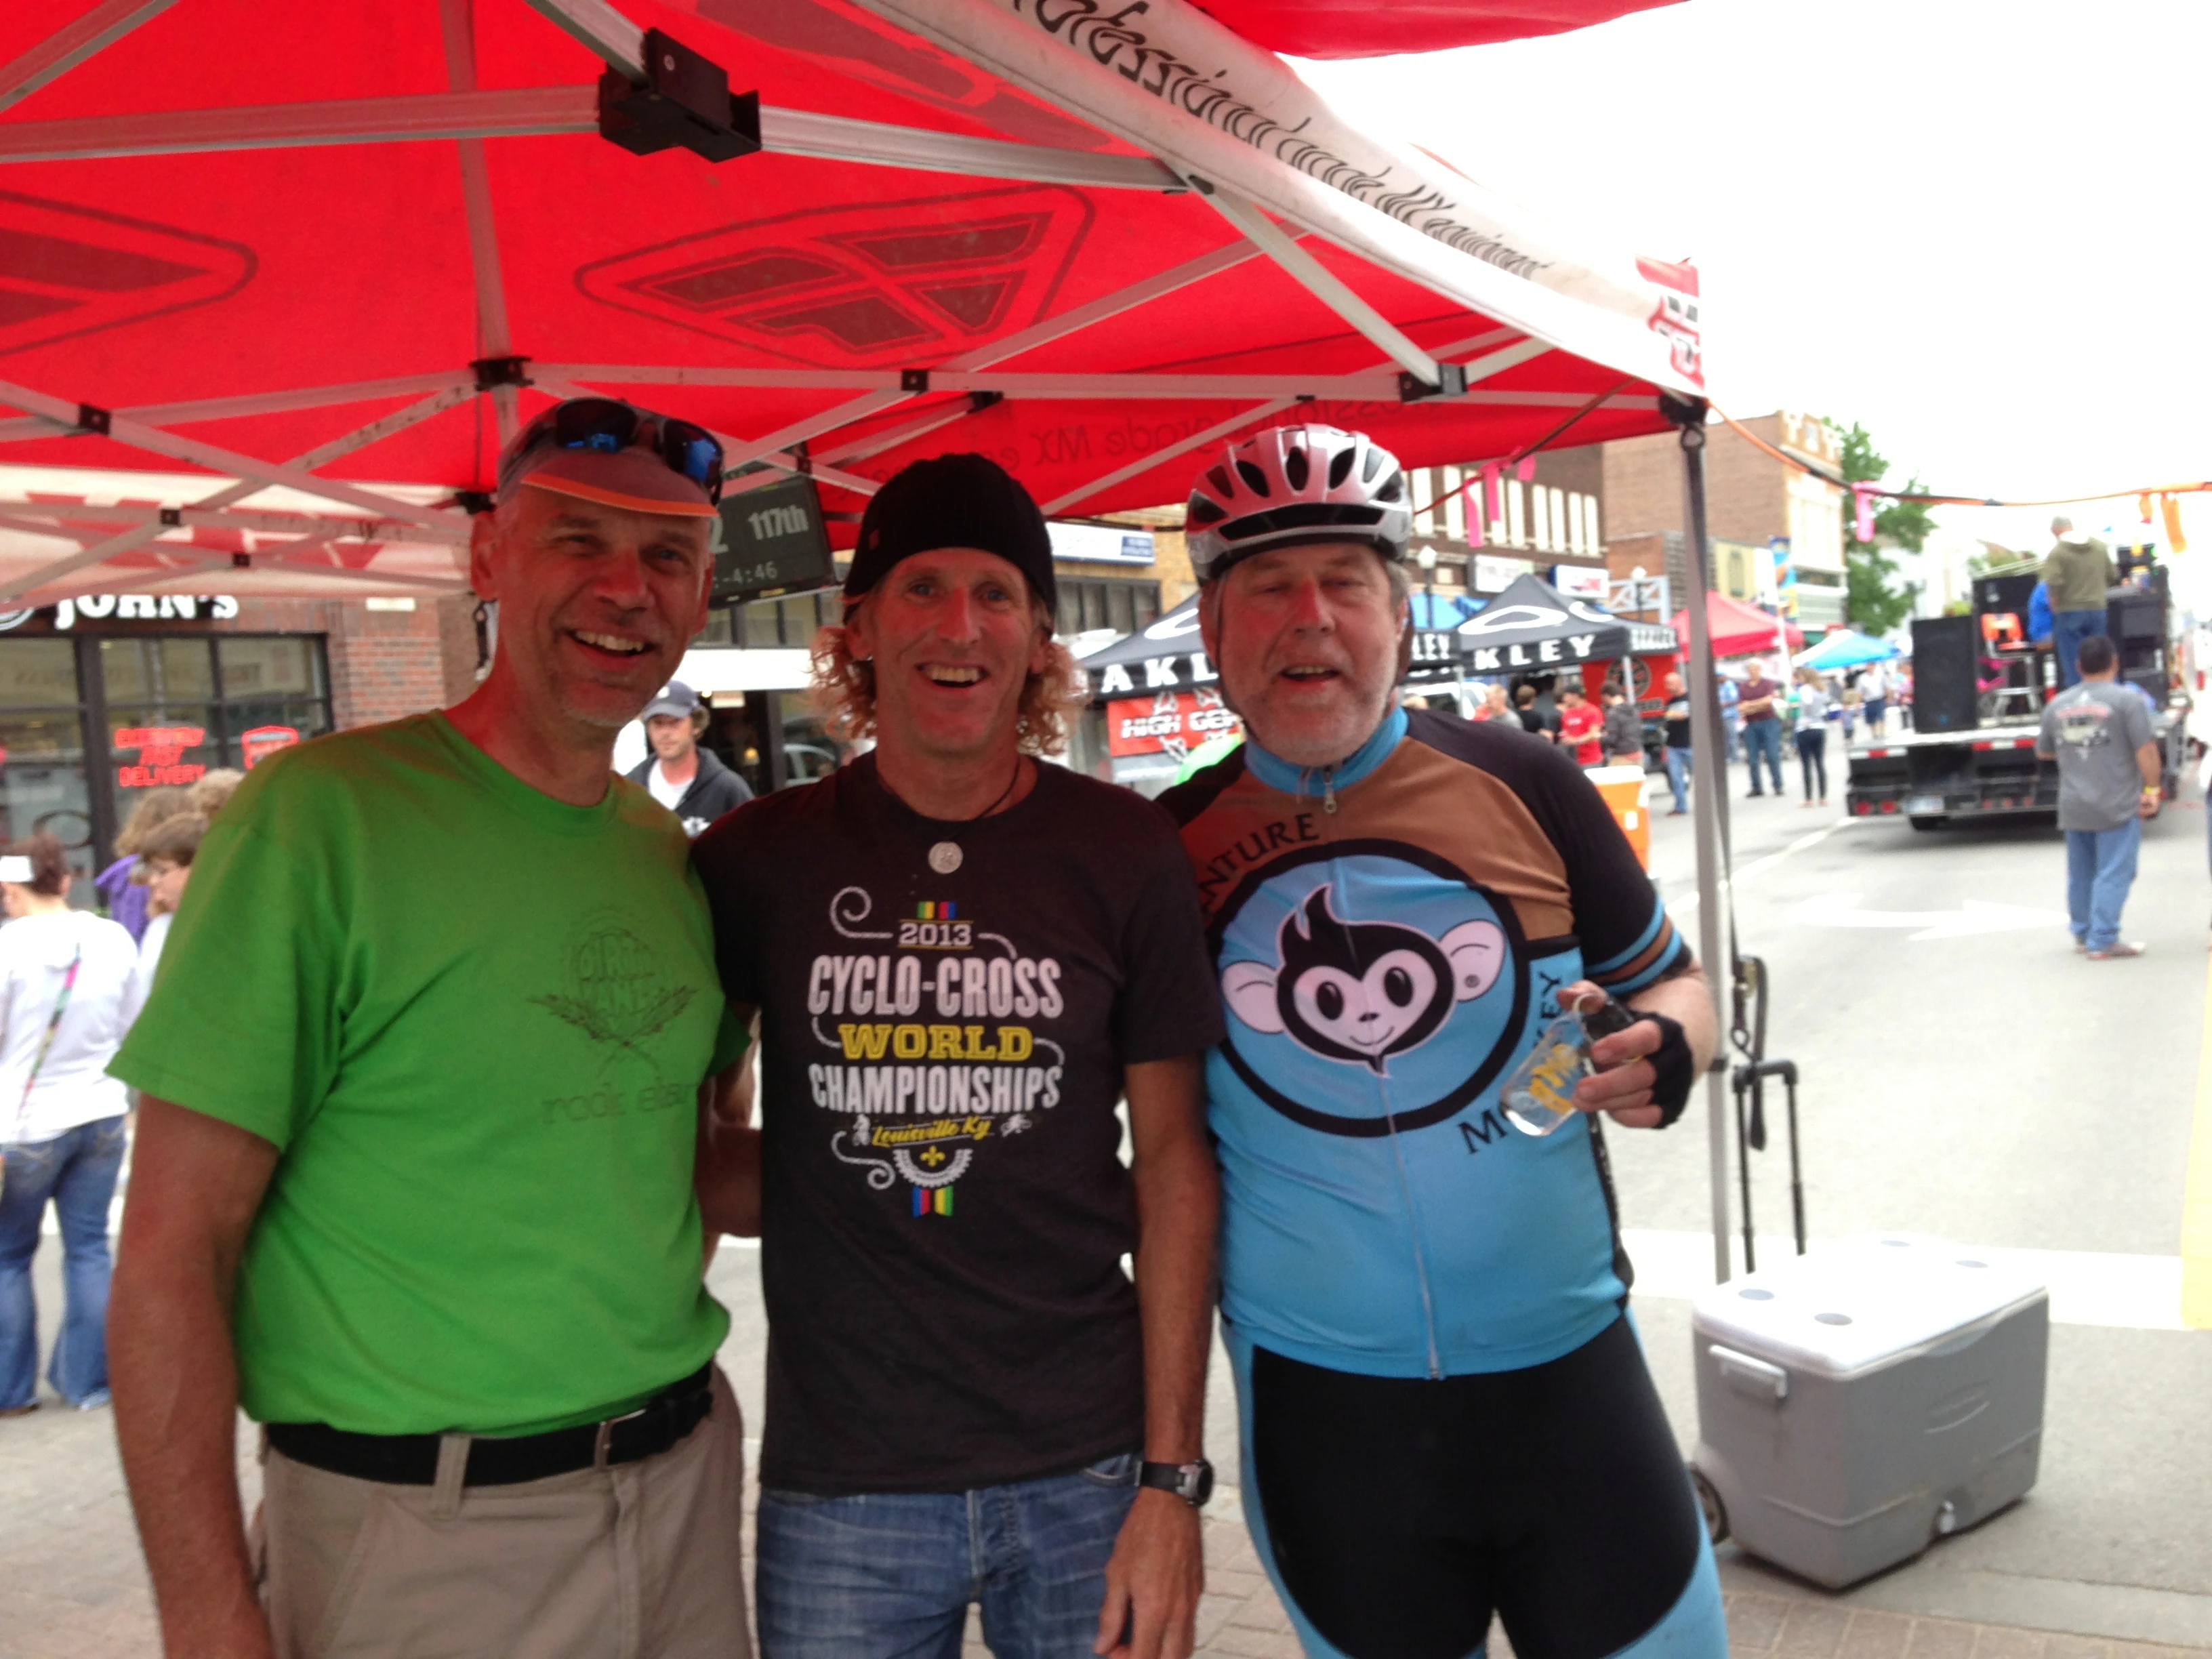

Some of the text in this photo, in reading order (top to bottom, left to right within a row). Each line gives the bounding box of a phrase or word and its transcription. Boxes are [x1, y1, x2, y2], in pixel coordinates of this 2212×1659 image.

[899, 922, 972, 946] 2013
[807, 954, 1064, 1019] CYCLO-CROSS
[838, 1023, 1033, 1061] WORLD
[808, 1063, 1063, 1114] CHAMPIONSHIPS
[872, 1119, 959, 1148] Louisville
